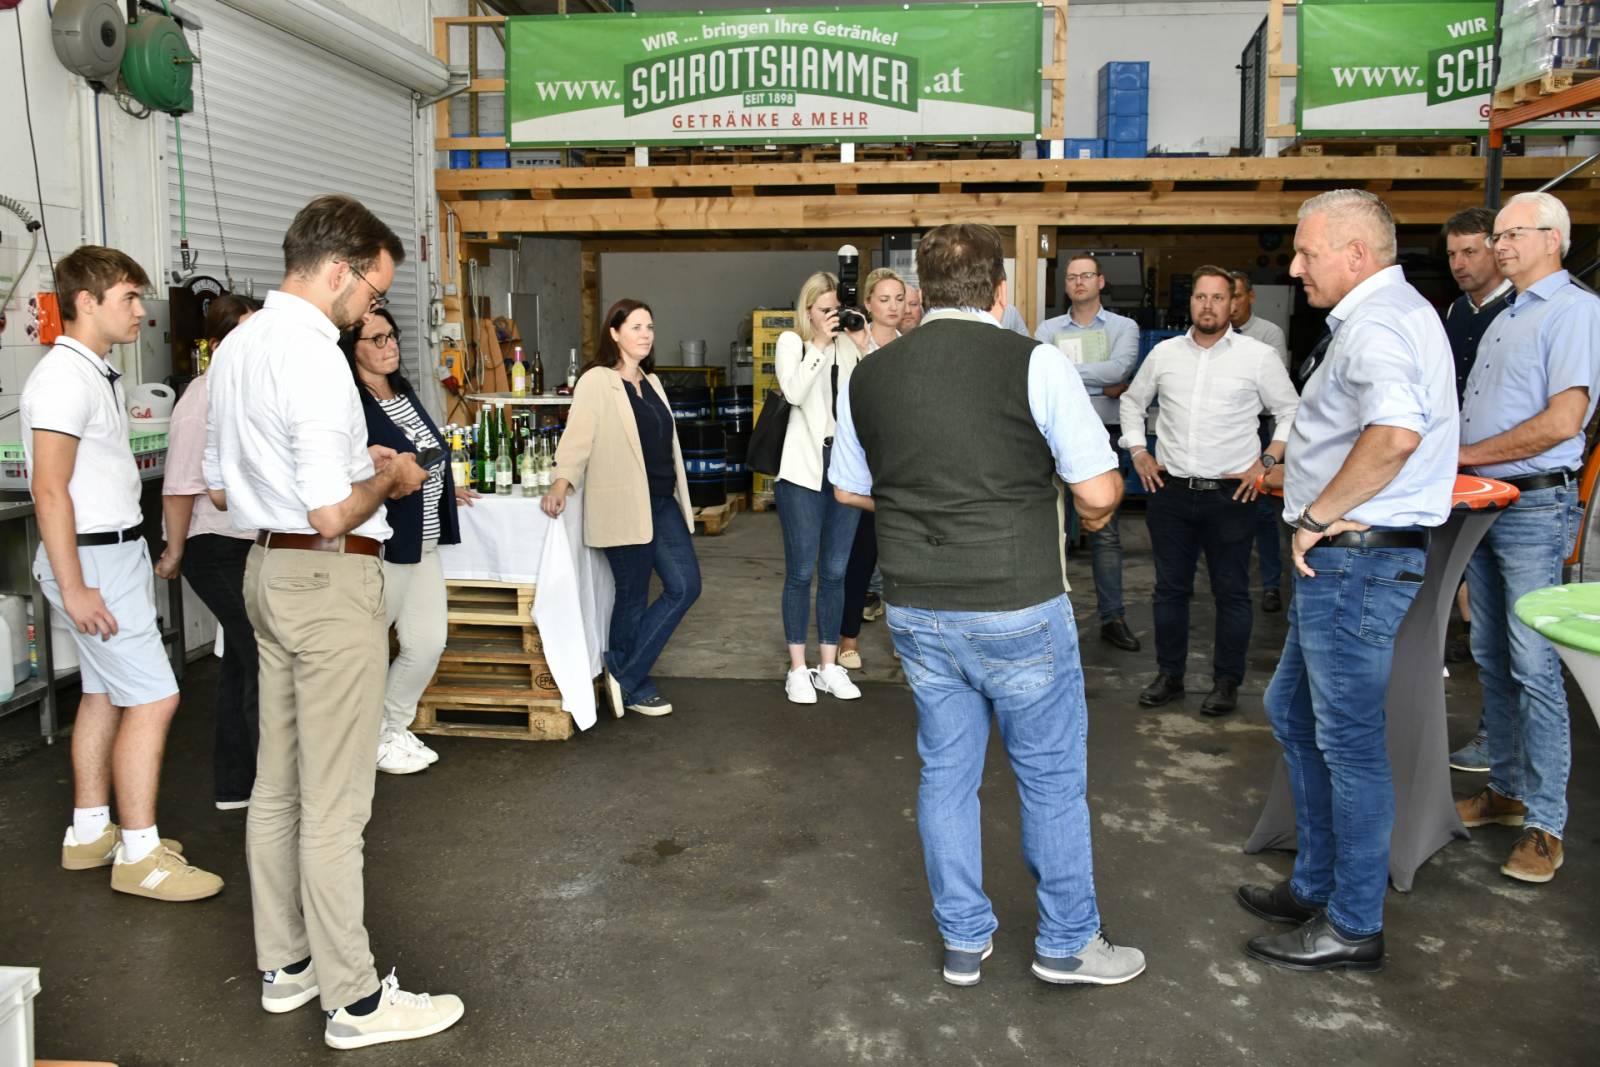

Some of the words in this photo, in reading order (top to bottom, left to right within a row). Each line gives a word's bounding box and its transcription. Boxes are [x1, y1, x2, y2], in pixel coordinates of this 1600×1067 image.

[641, 31, 679, 52] WIR
[702, 22, 769, 39] bringen
[774, 18, 808, 34] Ihre
[813, 20, 899, 46] Getränke!
[1447, 17, 1488, 38] WIR
[535, 80, 621, 101] www.
[632, 45, 909, 109] SCHROTTSHAMMER
[923, 66, 965, 93] .at
[1331, 66, 1425, 88] www.
[1436, 44, 1494, 98] SCH
[745, 92, 765, 105] SEIT
[768, 92, 794, 105] 1898
[672, 110, 780, 129] GETRÄNKE
[792, 112, 803, 127] &
[811, 111, 869, 127] MEHR
